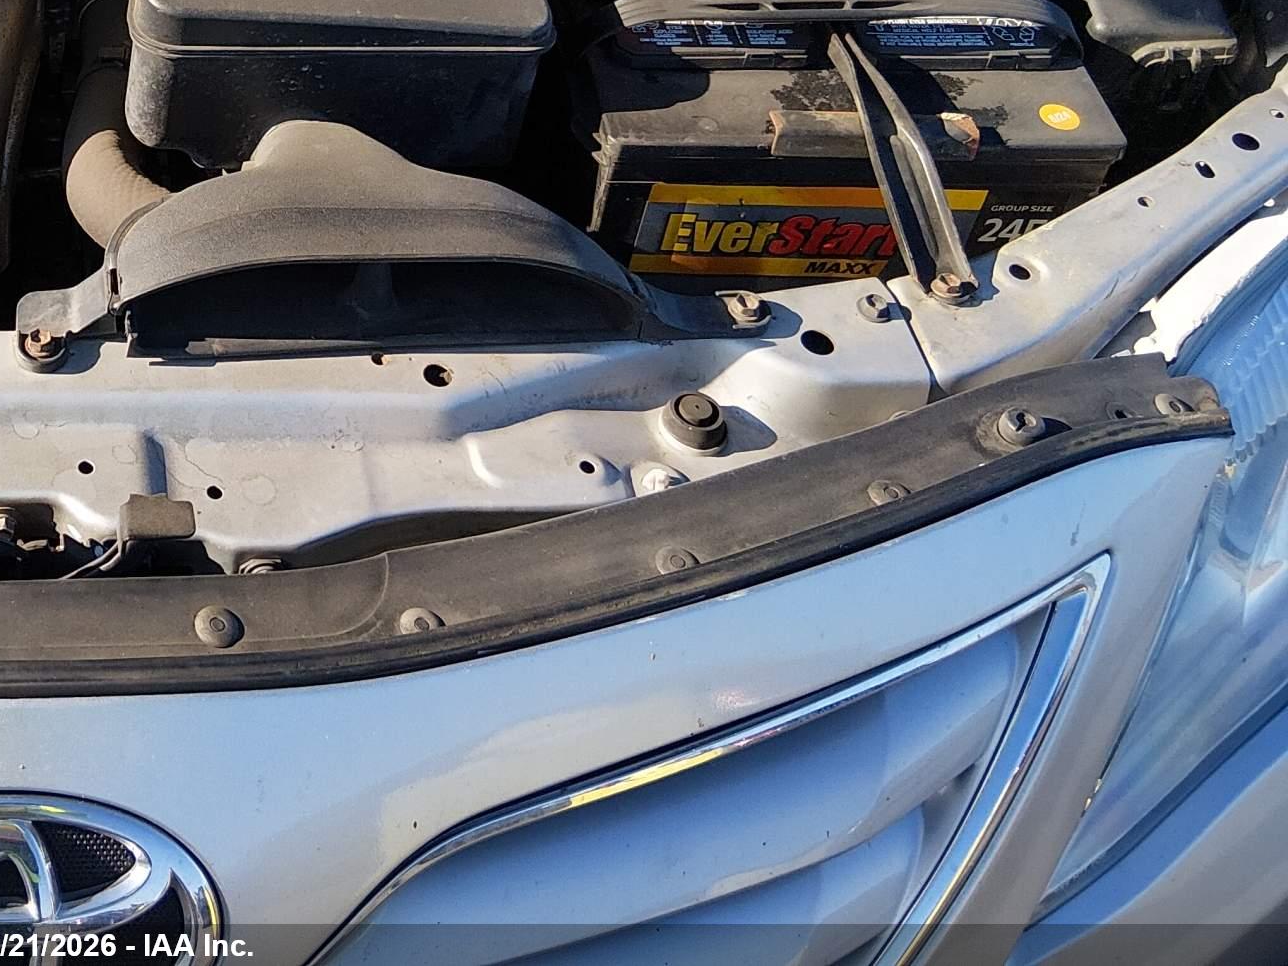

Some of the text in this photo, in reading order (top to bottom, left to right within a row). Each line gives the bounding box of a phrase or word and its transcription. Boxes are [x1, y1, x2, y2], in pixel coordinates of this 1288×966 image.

[990, 204, 1056, 213] GROUP SIZE
[804, 260, 877, 276] MAXX
